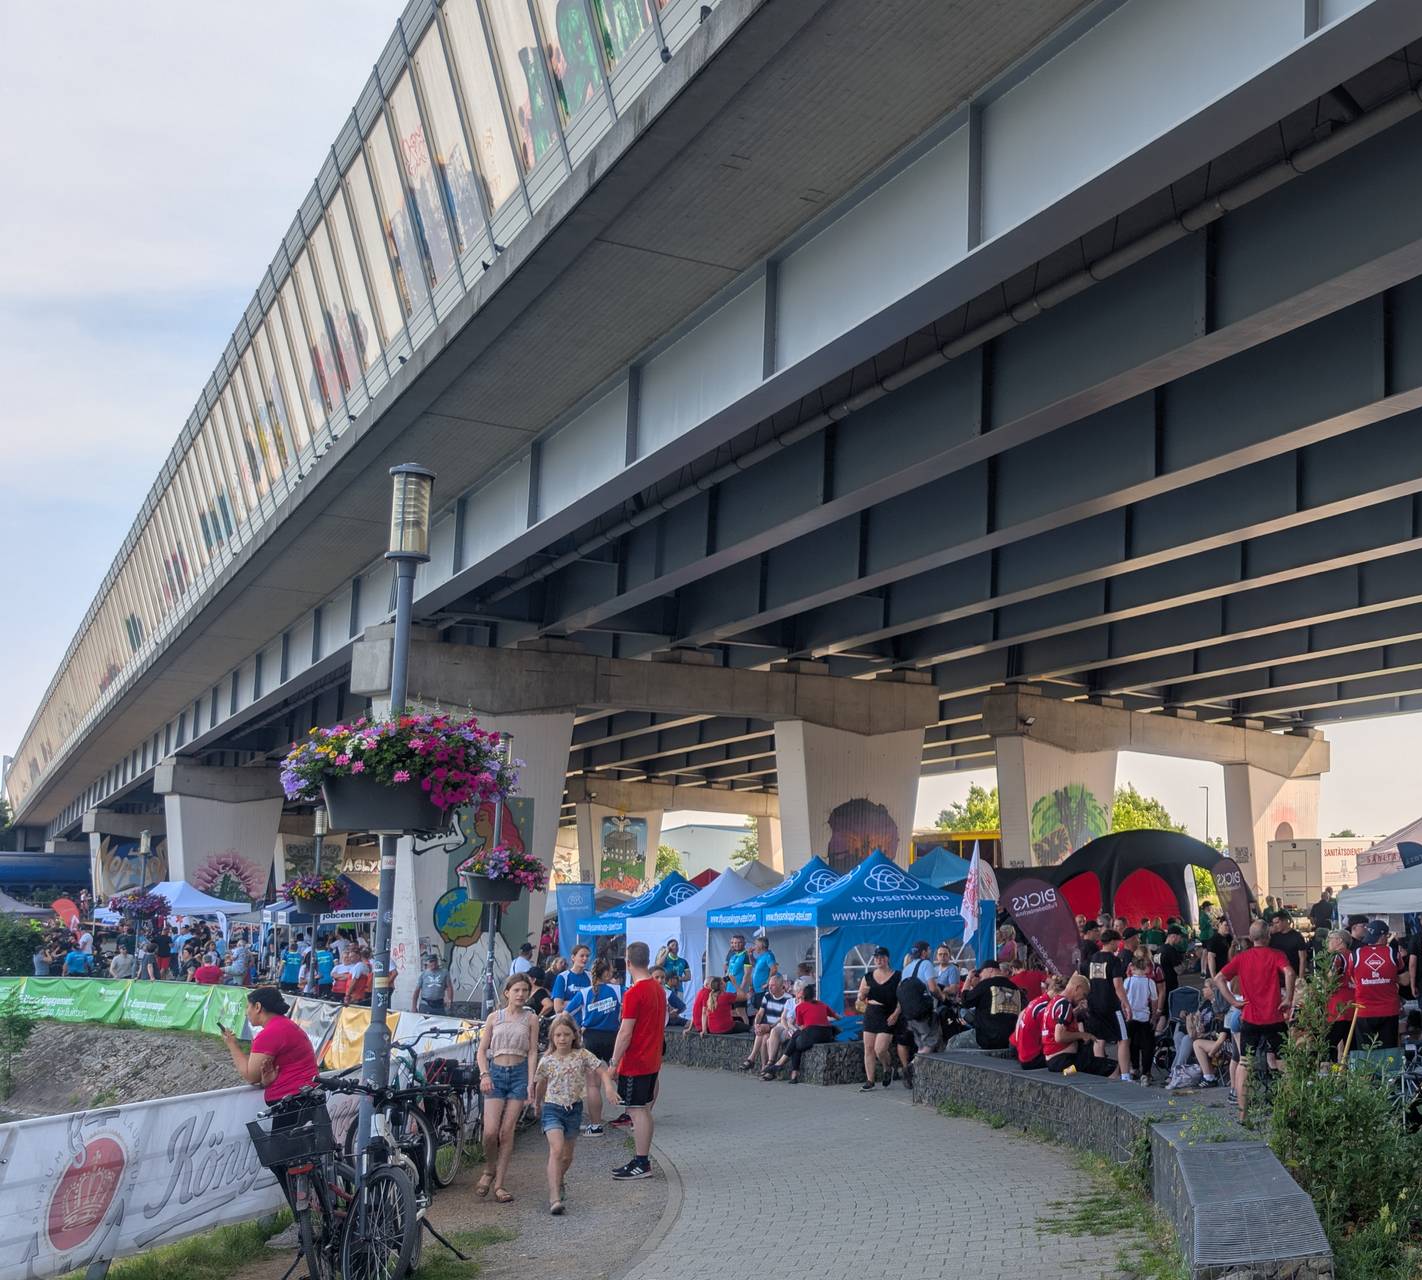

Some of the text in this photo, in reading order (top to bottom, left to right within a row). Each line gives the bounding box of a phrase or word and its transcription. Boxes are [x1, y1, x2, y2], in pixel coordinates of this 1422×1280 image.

[1324, 847, 1363, 857] SANITÄTSDIENST
[852, 893, 950, 903] thyssenkrupp
[322, 911, 363, 920] jobcenter
[832, 905, 982, 922] www.thyssenkrupp-steel.
